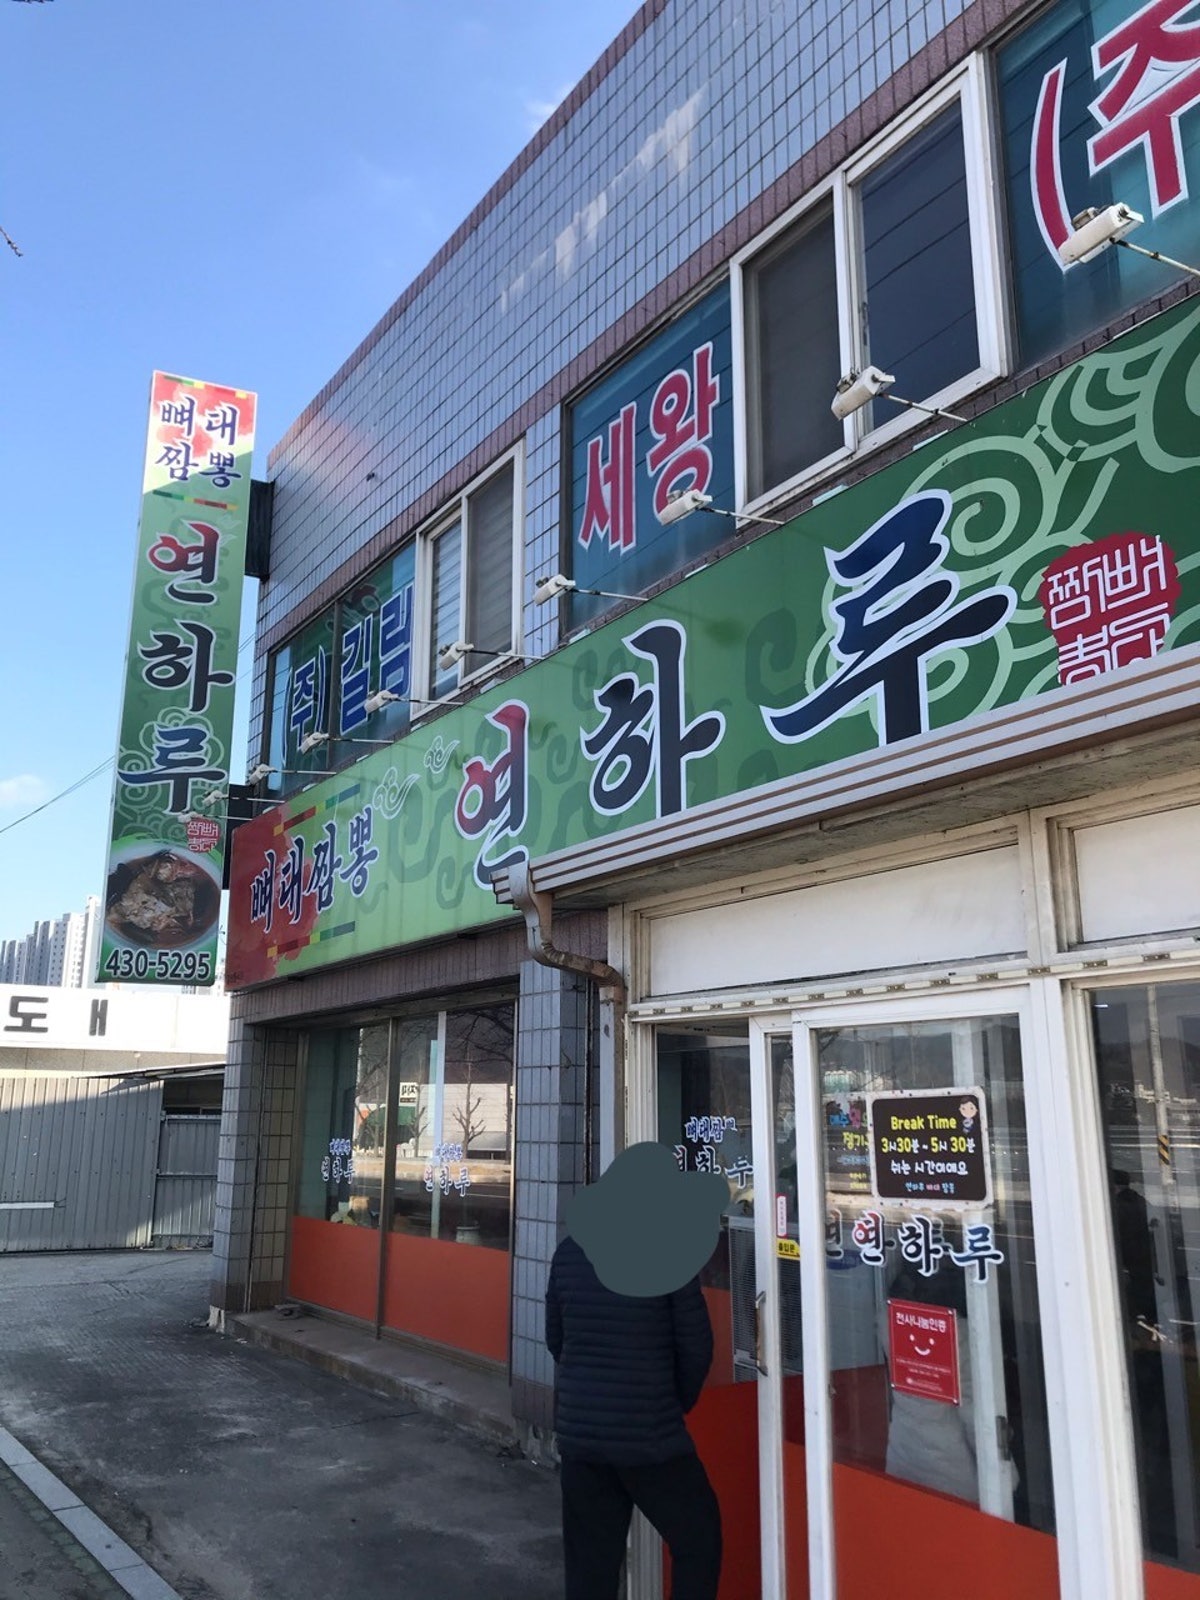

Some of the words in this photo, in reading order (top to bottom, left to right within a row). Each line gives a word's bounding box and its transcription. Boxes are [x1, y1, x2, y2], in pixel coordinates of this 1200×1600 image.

[160, 397, 239, 446] 뼈대
[155, 442, 242, 488] 짬뽕
[578, 341, 720, 557] 세왕
[117, 519, 235, 815] 연하루
[455, 488, 1018, 890] 연하루
[250, 803, 379, 934] 뼈대짬뽕
[105, 948, 211, 980] 430-5295
[881, 1137, 920, 1153] 3시30분
[930, 1137, 947, 1152] 5시
[950, 1136, 975, 1153] 30분
[890, 1116, 925, 1130] Break
[927, 1115, 957, 1129] Time
[891, 1160, 911, 1175] 쉬는
[915, 1160, 968, 1175] 시간이에요
[852, 1210, 1004, 1283] 연하루
